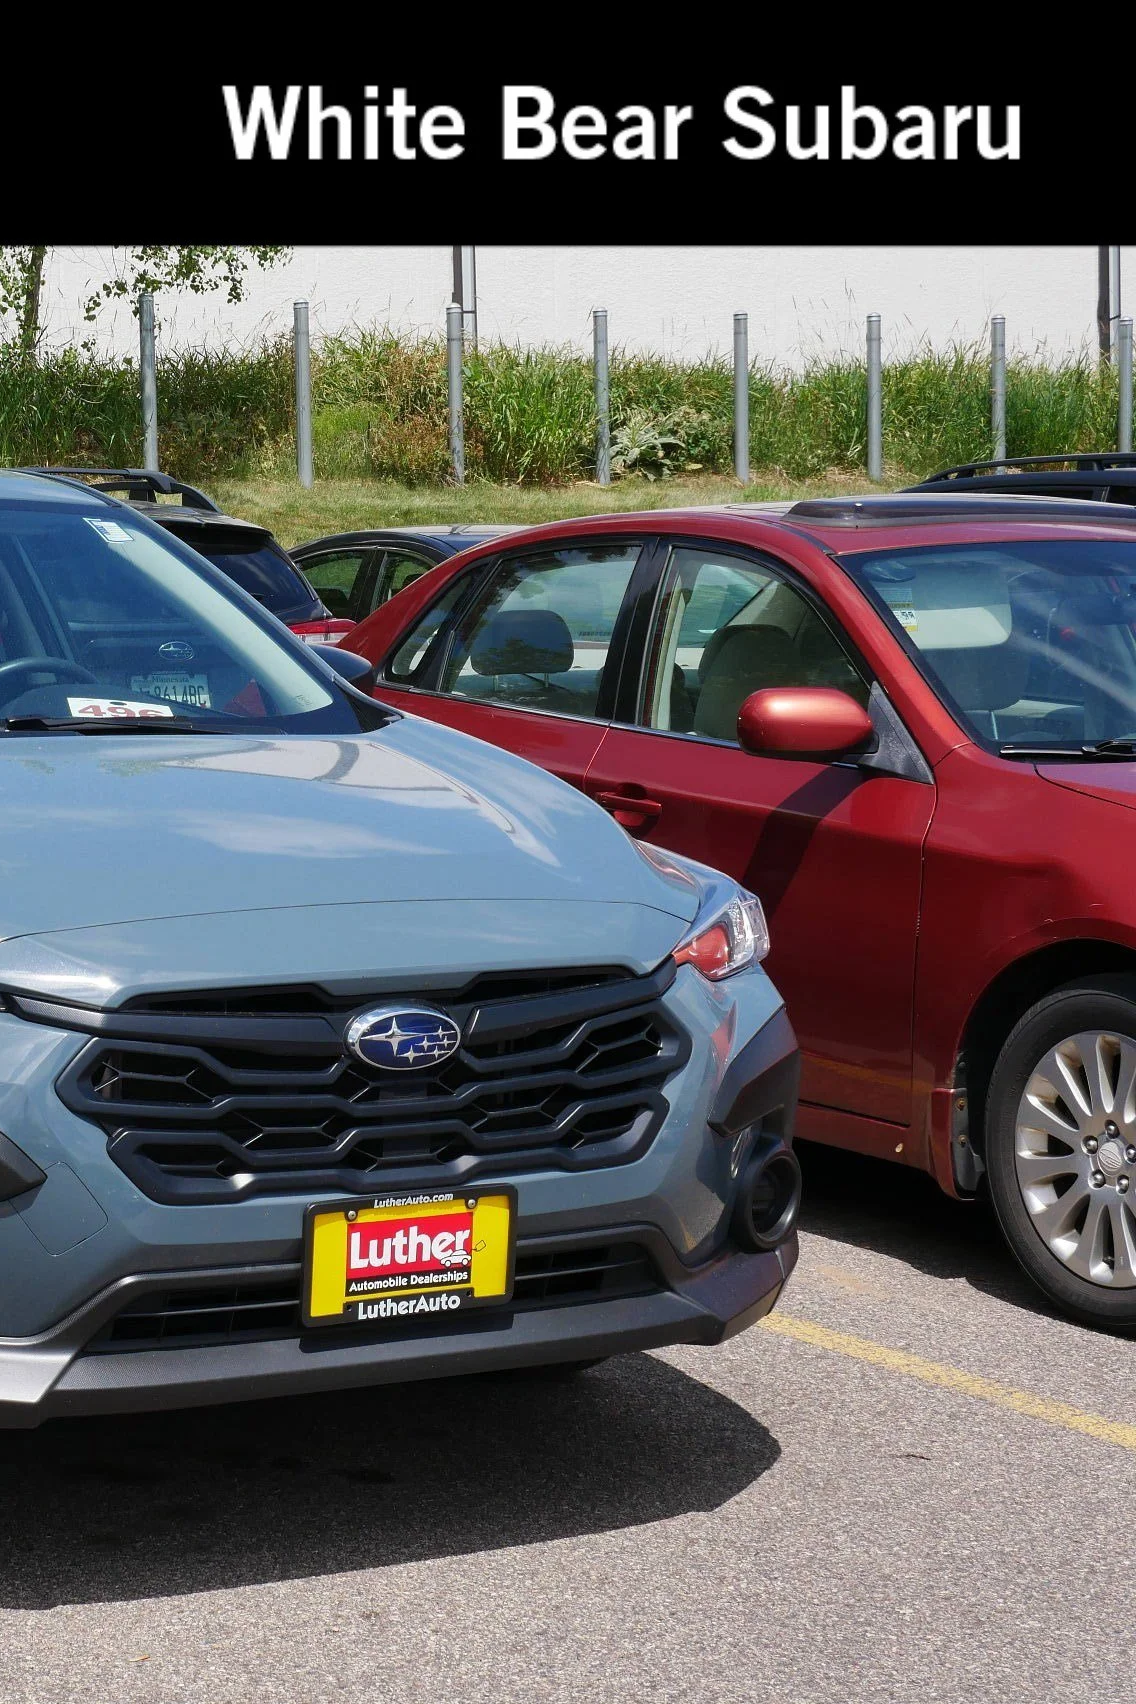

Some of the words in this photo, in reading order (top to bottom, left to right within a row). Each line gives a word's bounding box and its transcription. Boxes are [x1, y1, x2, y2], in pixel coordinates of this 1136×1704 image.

[373, 1193, 454, 1209] LutherAuto.com
[350, 1225, 470, 1270] Luther
[348, 1275, 408, 1293] Automobile
[410, 1270, 469, 1286] Dealerships
[358, 1293, 461, 1320] LutherAuto
